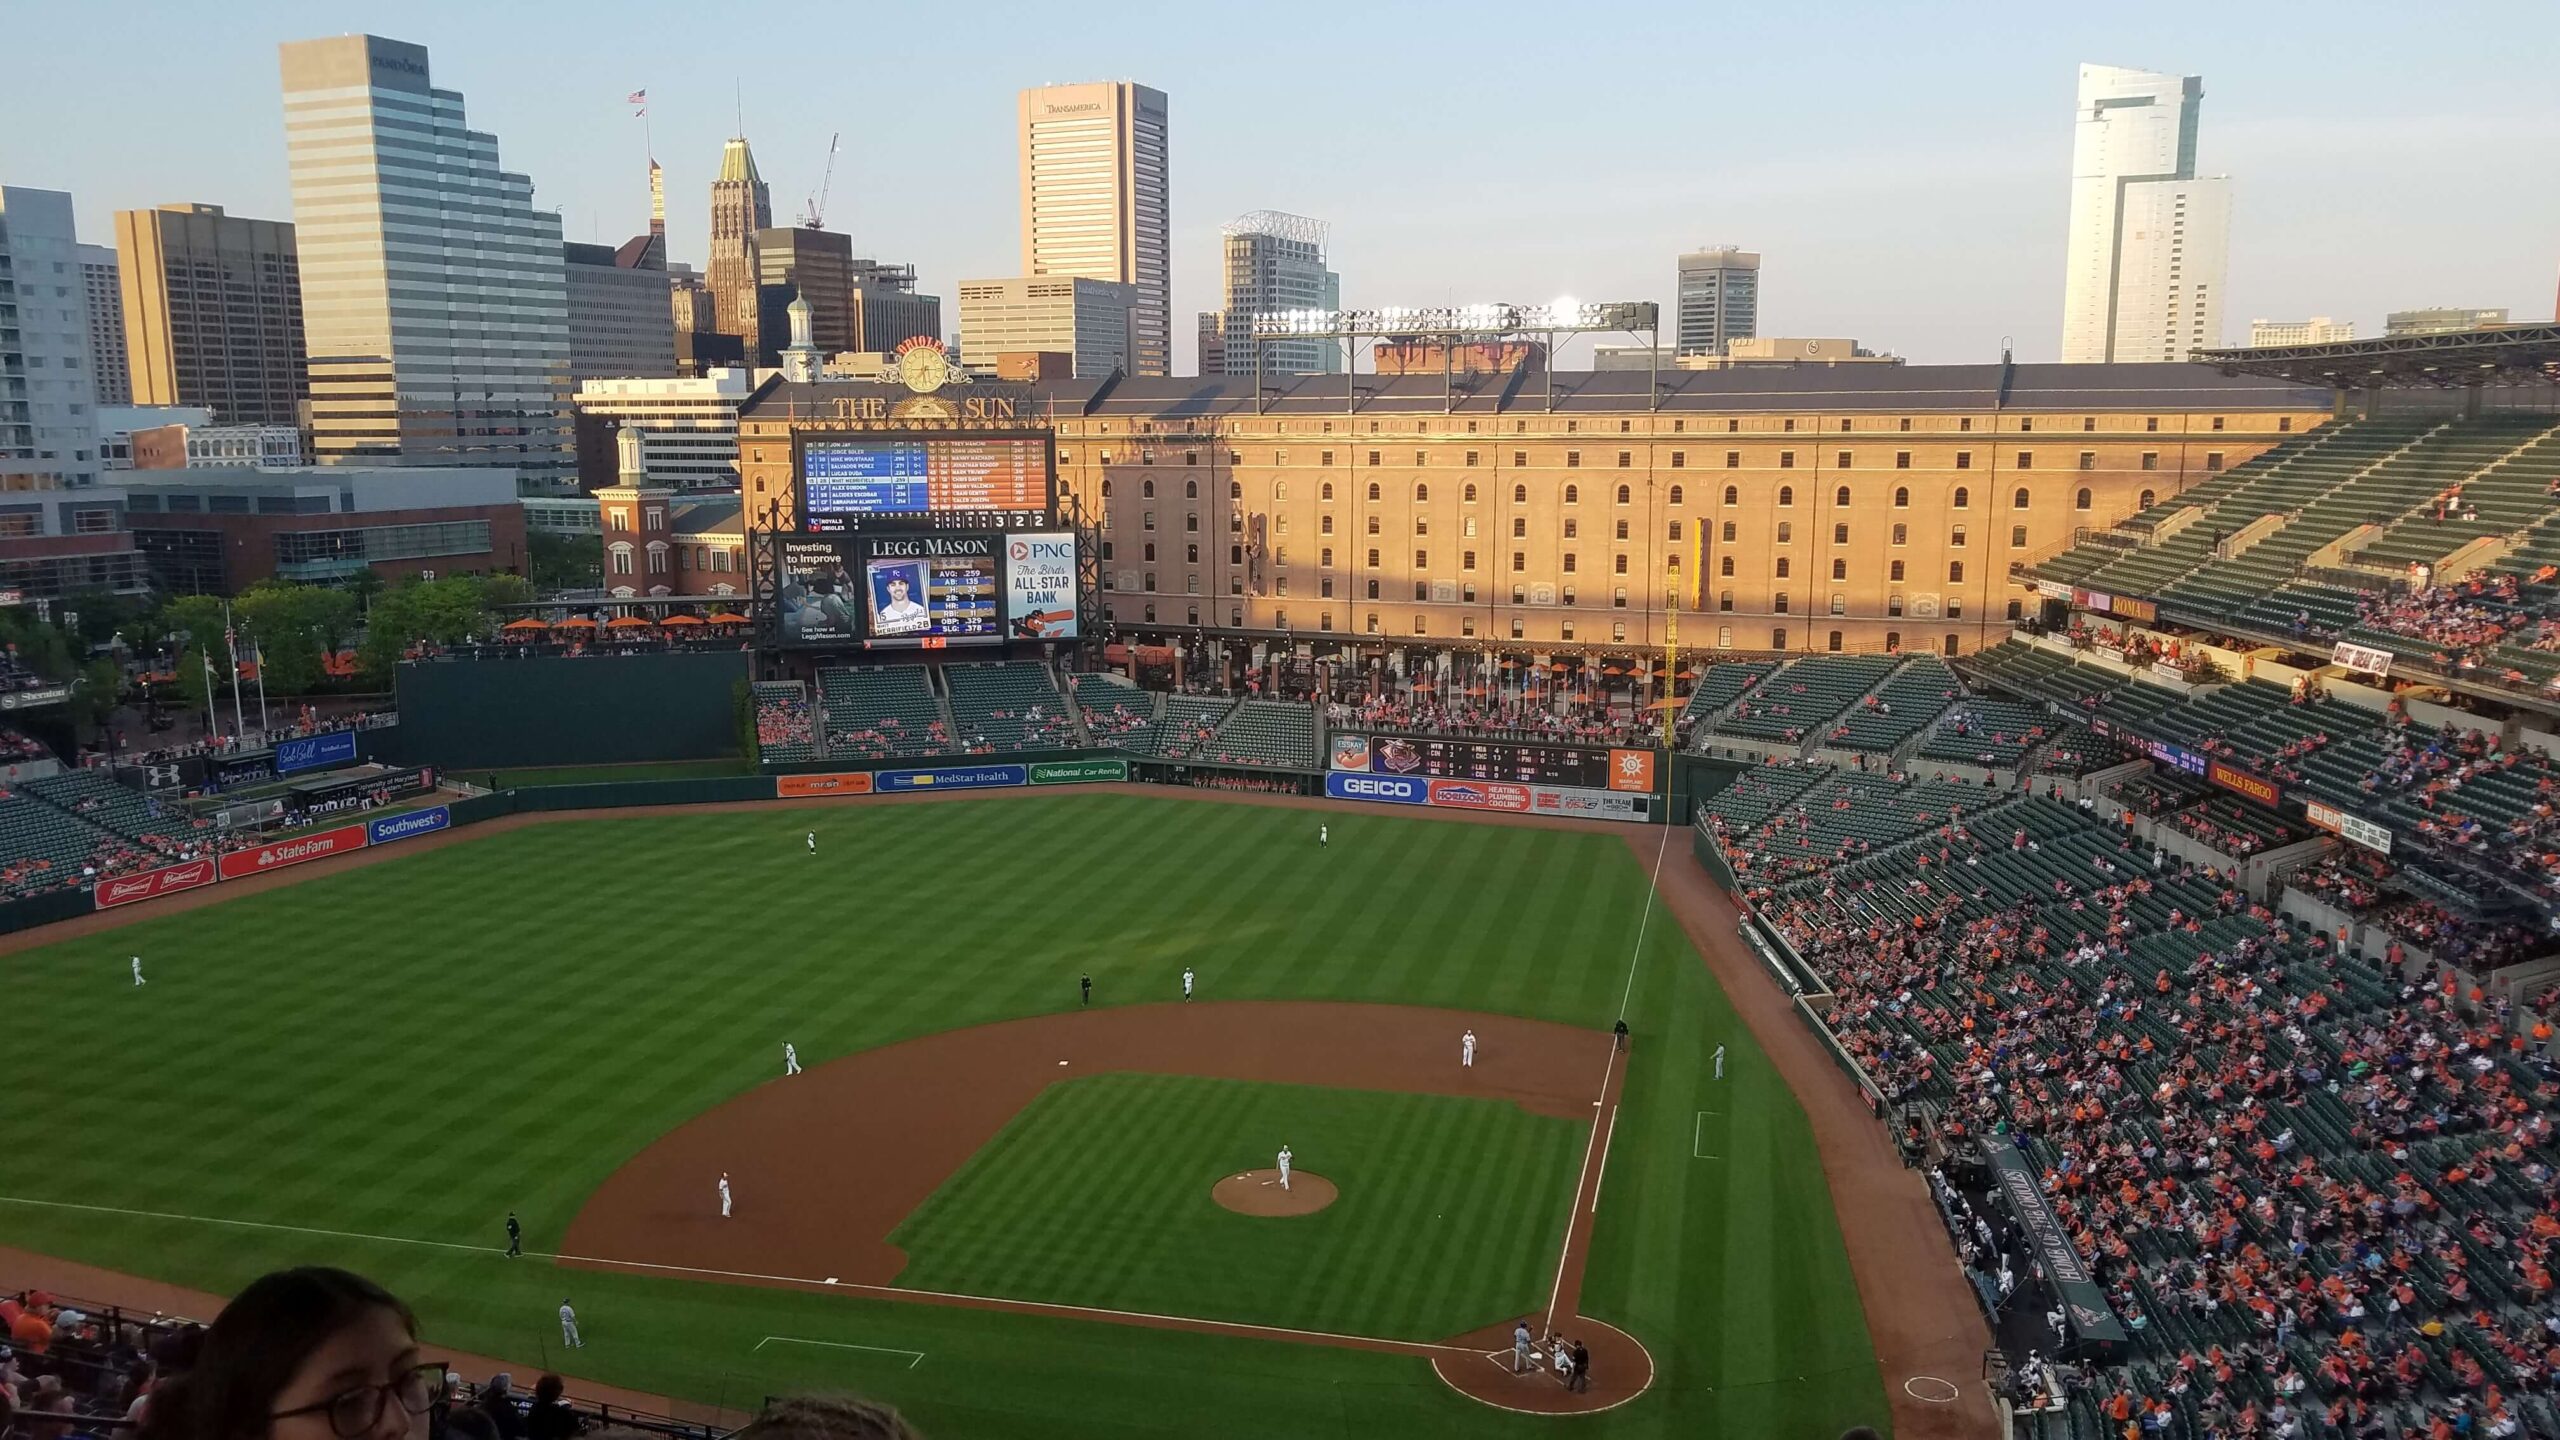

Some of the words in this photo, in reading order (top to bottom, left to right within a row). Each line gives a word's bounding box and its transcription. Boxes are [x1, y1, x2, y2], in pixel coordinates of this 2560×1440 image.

[1047, 103, 1101, 113] TRANSAMERICA
[896, 336, 948, 355] ORIOLES
[832, 398, 886, 419] THE
[965, 397, 1015, 419] SUN
[996, 517, 1004, 527] 3
[1016, 517, 1024, 527] 2
[1035, 516, 1044, 526] 2
[786, 542, 832, 553] Investing
[872, 540, 920, 556] LEGG
[924, 538, 988, 554] MASON
[1031, 543, 1072, 558] PNC
[786, 555, 798, 563] to
[800, 554, 841, 564] Improve
[1017, 564, 1036, 576] The
[1038, 564, 1065, 575] Birds
[1015, 576, 1069, 590] ALL-STAR
[1027, 591, 1057, 604] BANK
[2113, 597, 2141, 617] ROMA
[876, 624, 917, 634] MERRIFIELD
[1337, 741, 1363, 749] ESSKAY
[936, 775, 974, 784] MedStar
[976, 773, 1009, 782] Health
[1046, 768, 1080, 778] National
[1344, 778, 1412, 797] GEICO
[2216, 768, 2243, 788] WELLS
[2244, 778, 2272, 800] FARGO
[1488, 786, 1520, 794] HEATING
[1437, 791, 1484, 802] HORIZON
[1488, 793, 1526, 802] PLUMBING
[1488, 800, 1520, 808] COOLING
[378, 814, 435, 837] Southwest
[2044, 1248, 2082, 1281] HOME
